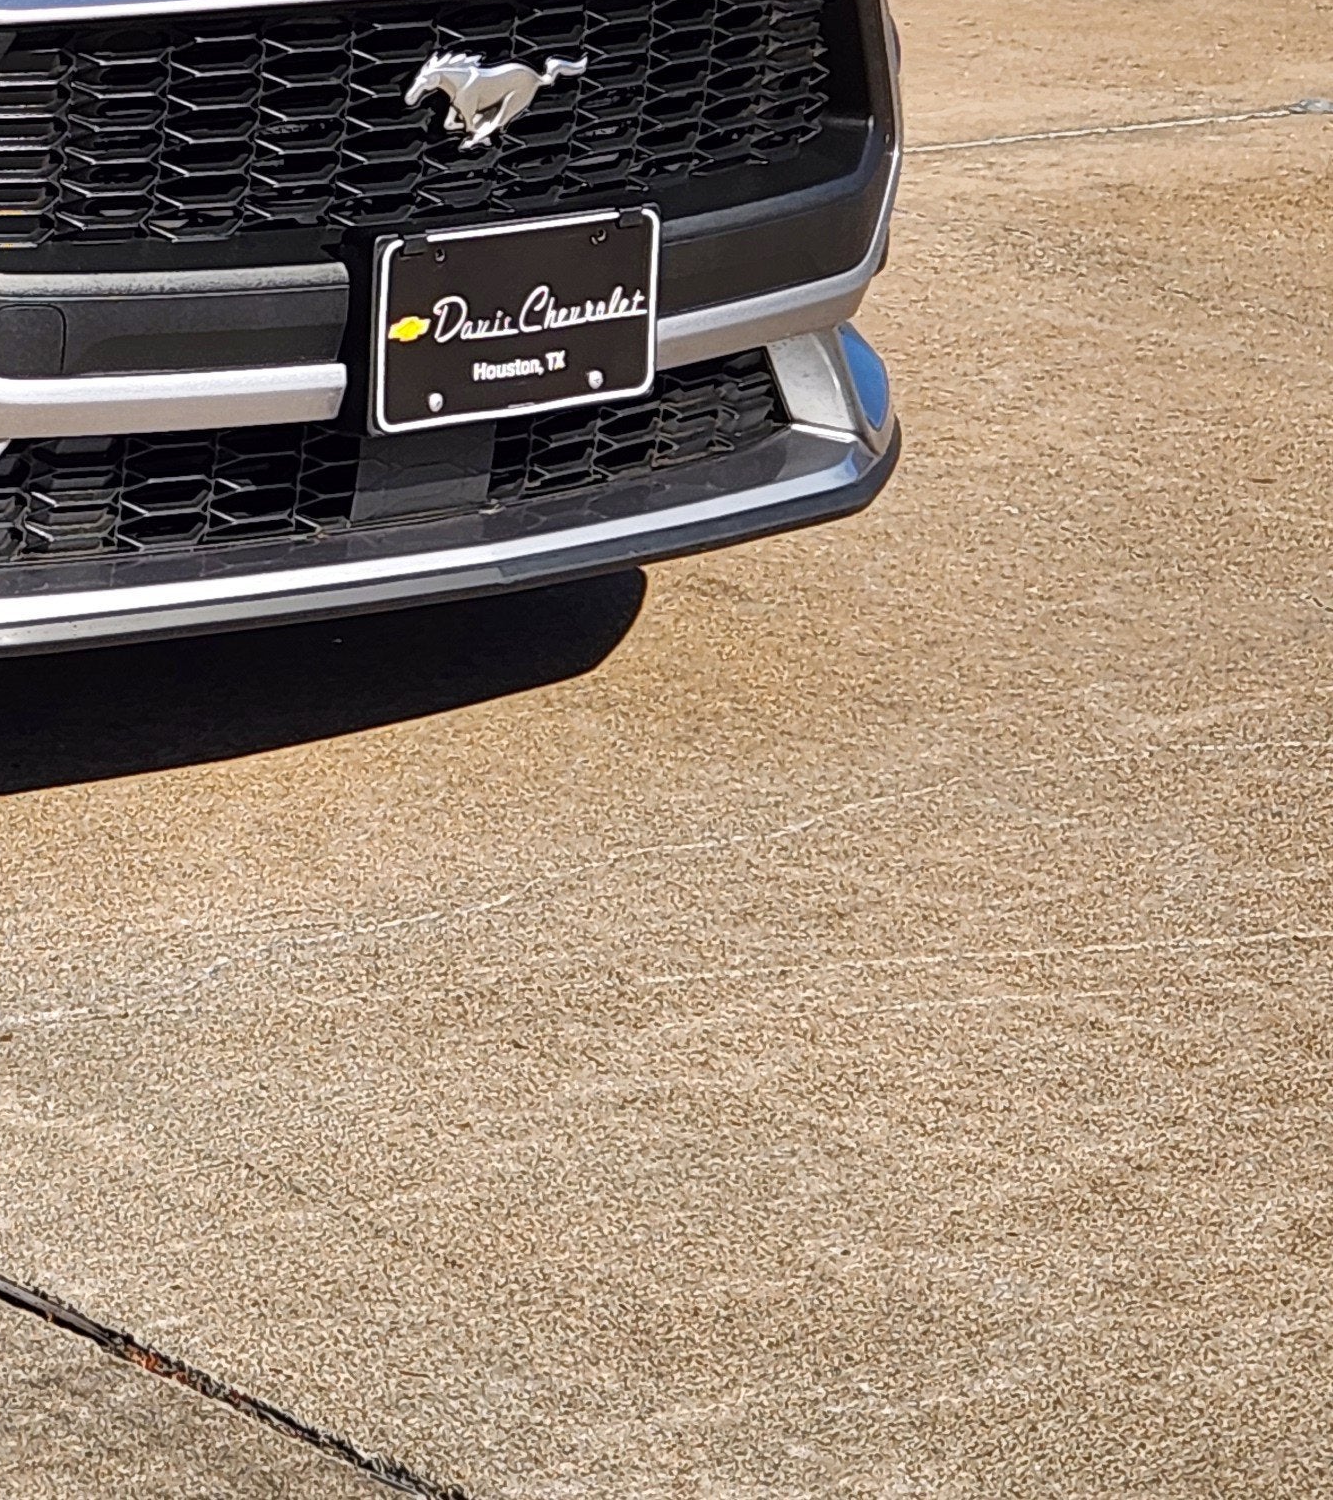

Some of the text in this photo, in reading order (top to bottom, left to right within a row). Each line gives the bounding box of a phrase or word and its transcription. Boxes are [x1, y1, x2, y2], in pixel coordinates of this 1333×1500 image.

[433, 285, 648, 343] Davis Chevrolet
[472, 350, 566, 382] Houston, TX
